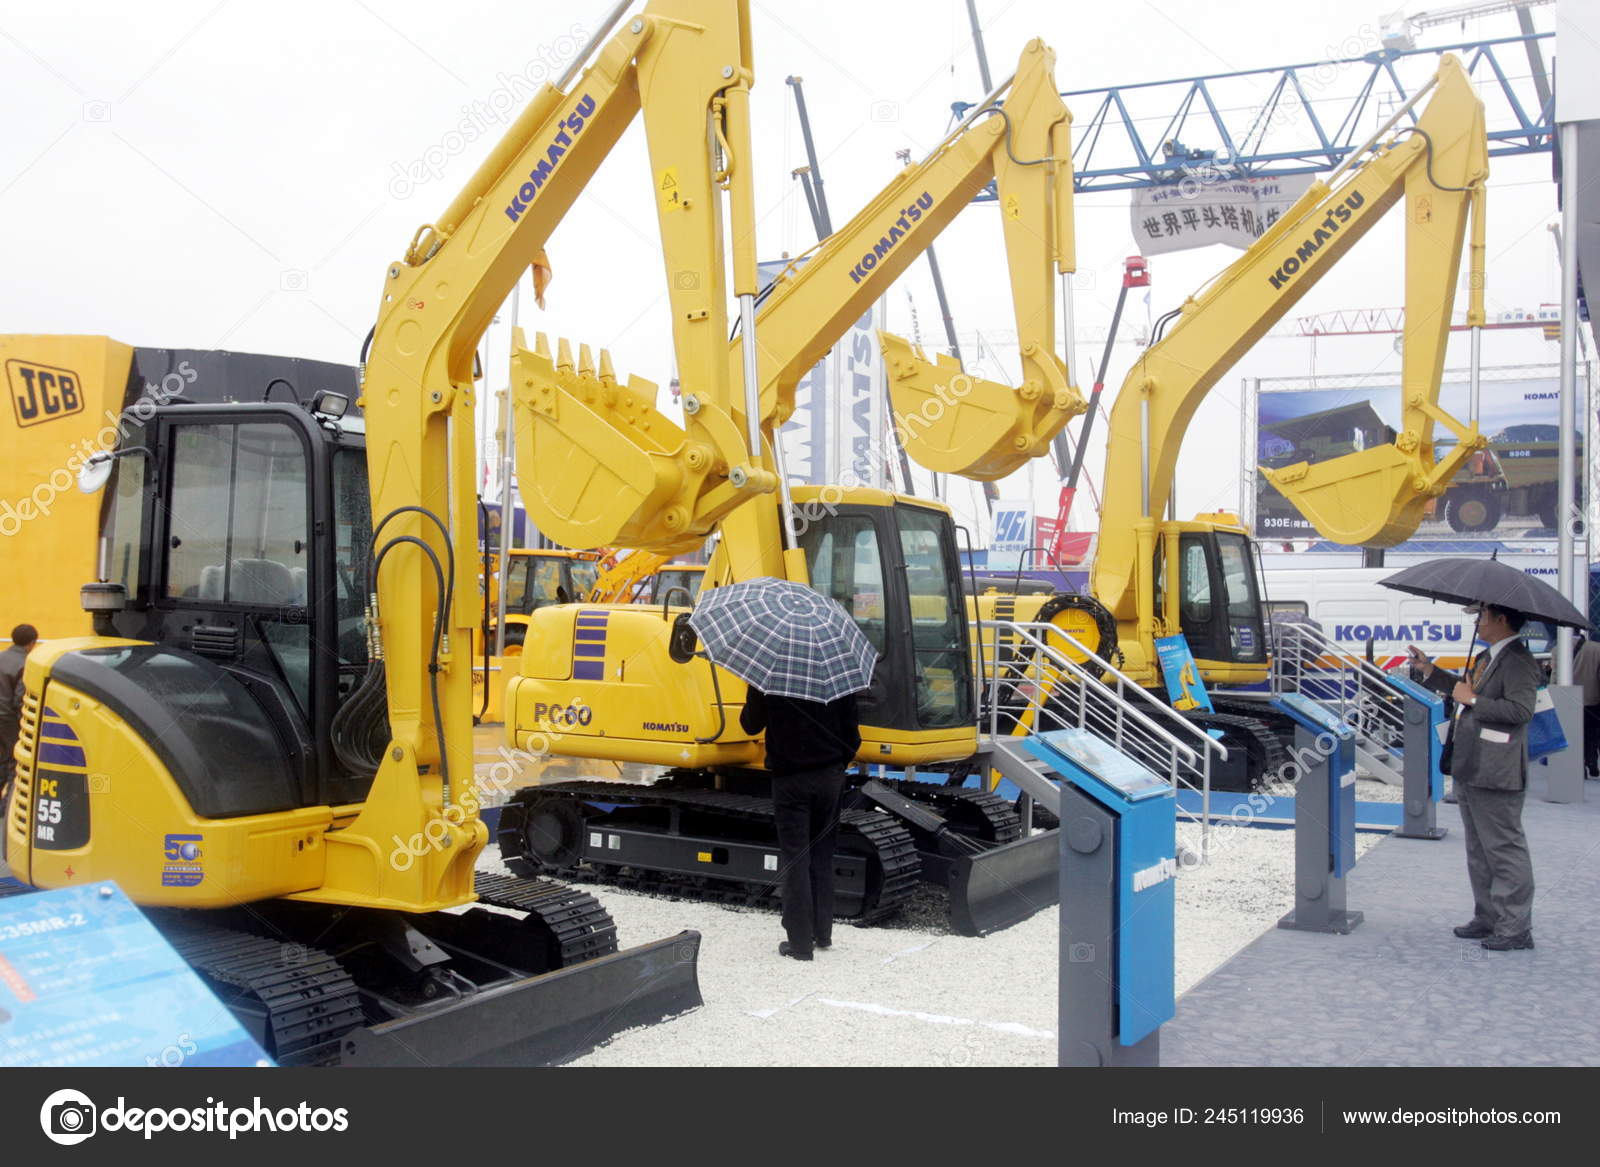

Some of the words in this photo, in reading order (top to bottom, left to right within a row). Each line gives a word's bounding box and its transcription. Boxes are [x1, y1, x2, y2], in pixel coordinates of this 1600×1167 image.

[505, 94, 596, 223] KOMATSU
[849, 192, 934, 284] KOMATSU
[1268, 190, 1365, 290] KOMATSU
[18, 368, 79, 420] JCB
[1335, 621, 1462, 642] KOMATSU
[642, 721, 689, 733] KOMATSU
[40, 778, 58, 798] PC
[37, 798, 62, 824] 55
[37, 824, 55, 842] MR
